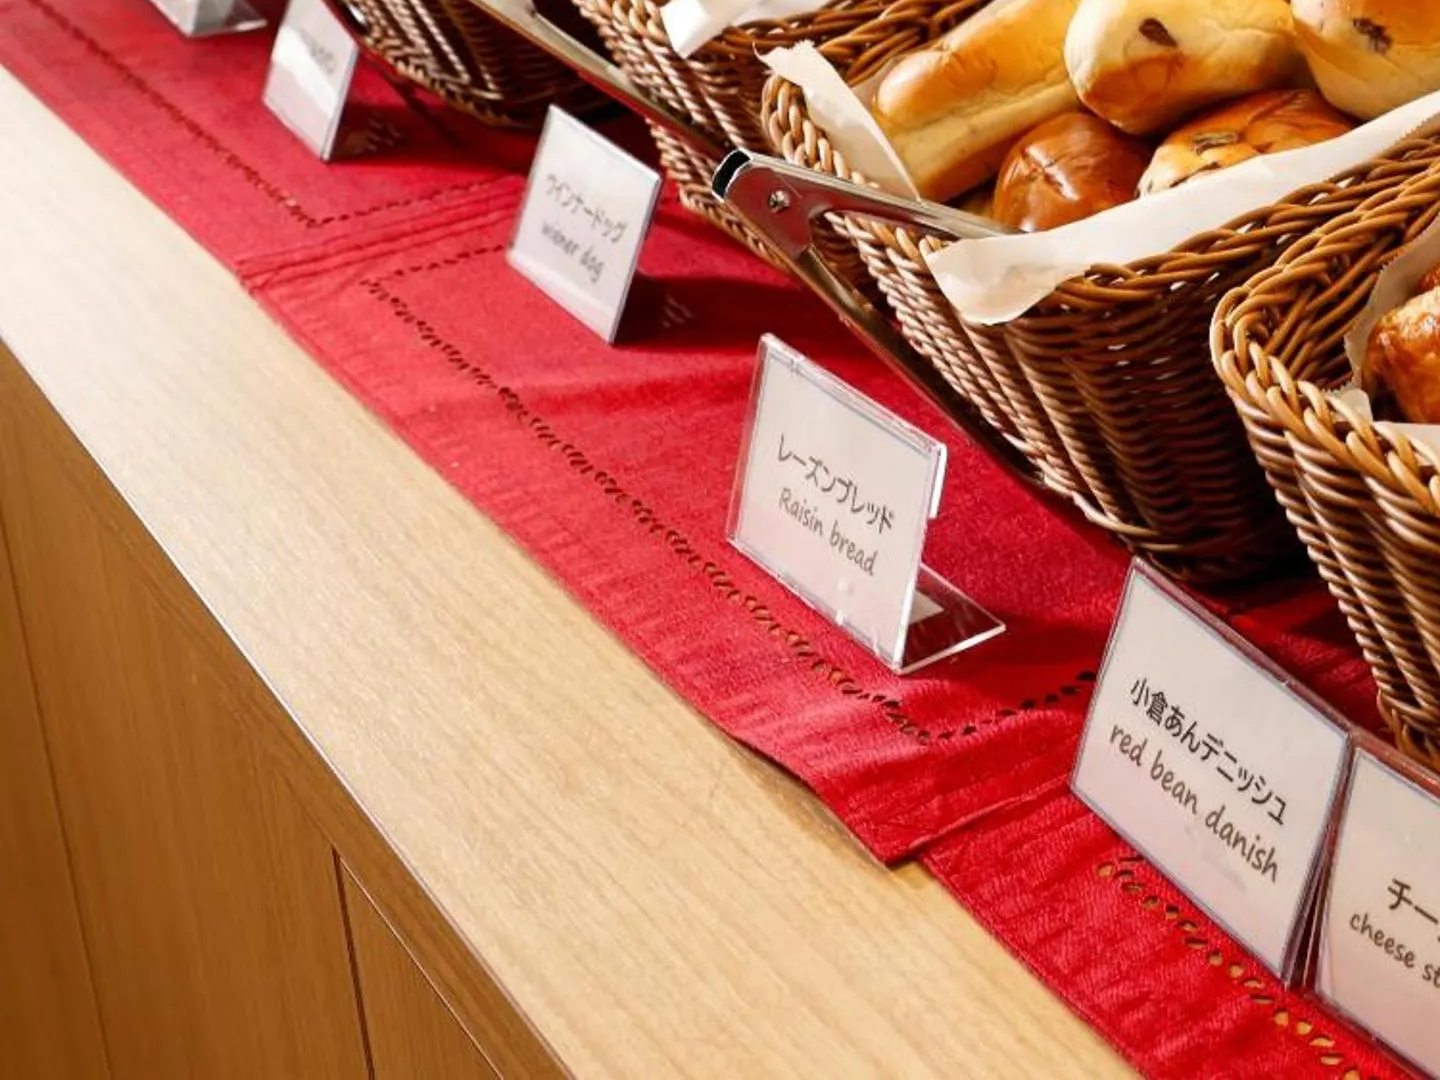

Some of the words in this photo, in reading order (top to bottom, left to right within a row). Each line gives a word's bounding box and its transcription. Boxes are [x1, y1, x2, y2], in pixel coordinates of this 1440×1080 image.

[776, 434, 895, 533] レーズンブレッド
[778, 487, 824, 537] Raisin
[829, 523, 878, 576] bread
[1130, 677, 1288, 826] 小倉あんデニッシュ
[1109, 724, 1148, 768] red
[1150, 749, 1199, 815] bean
[1204, 804, 1280, 883] danish
[1349, 912, 1415, 969] cheese
